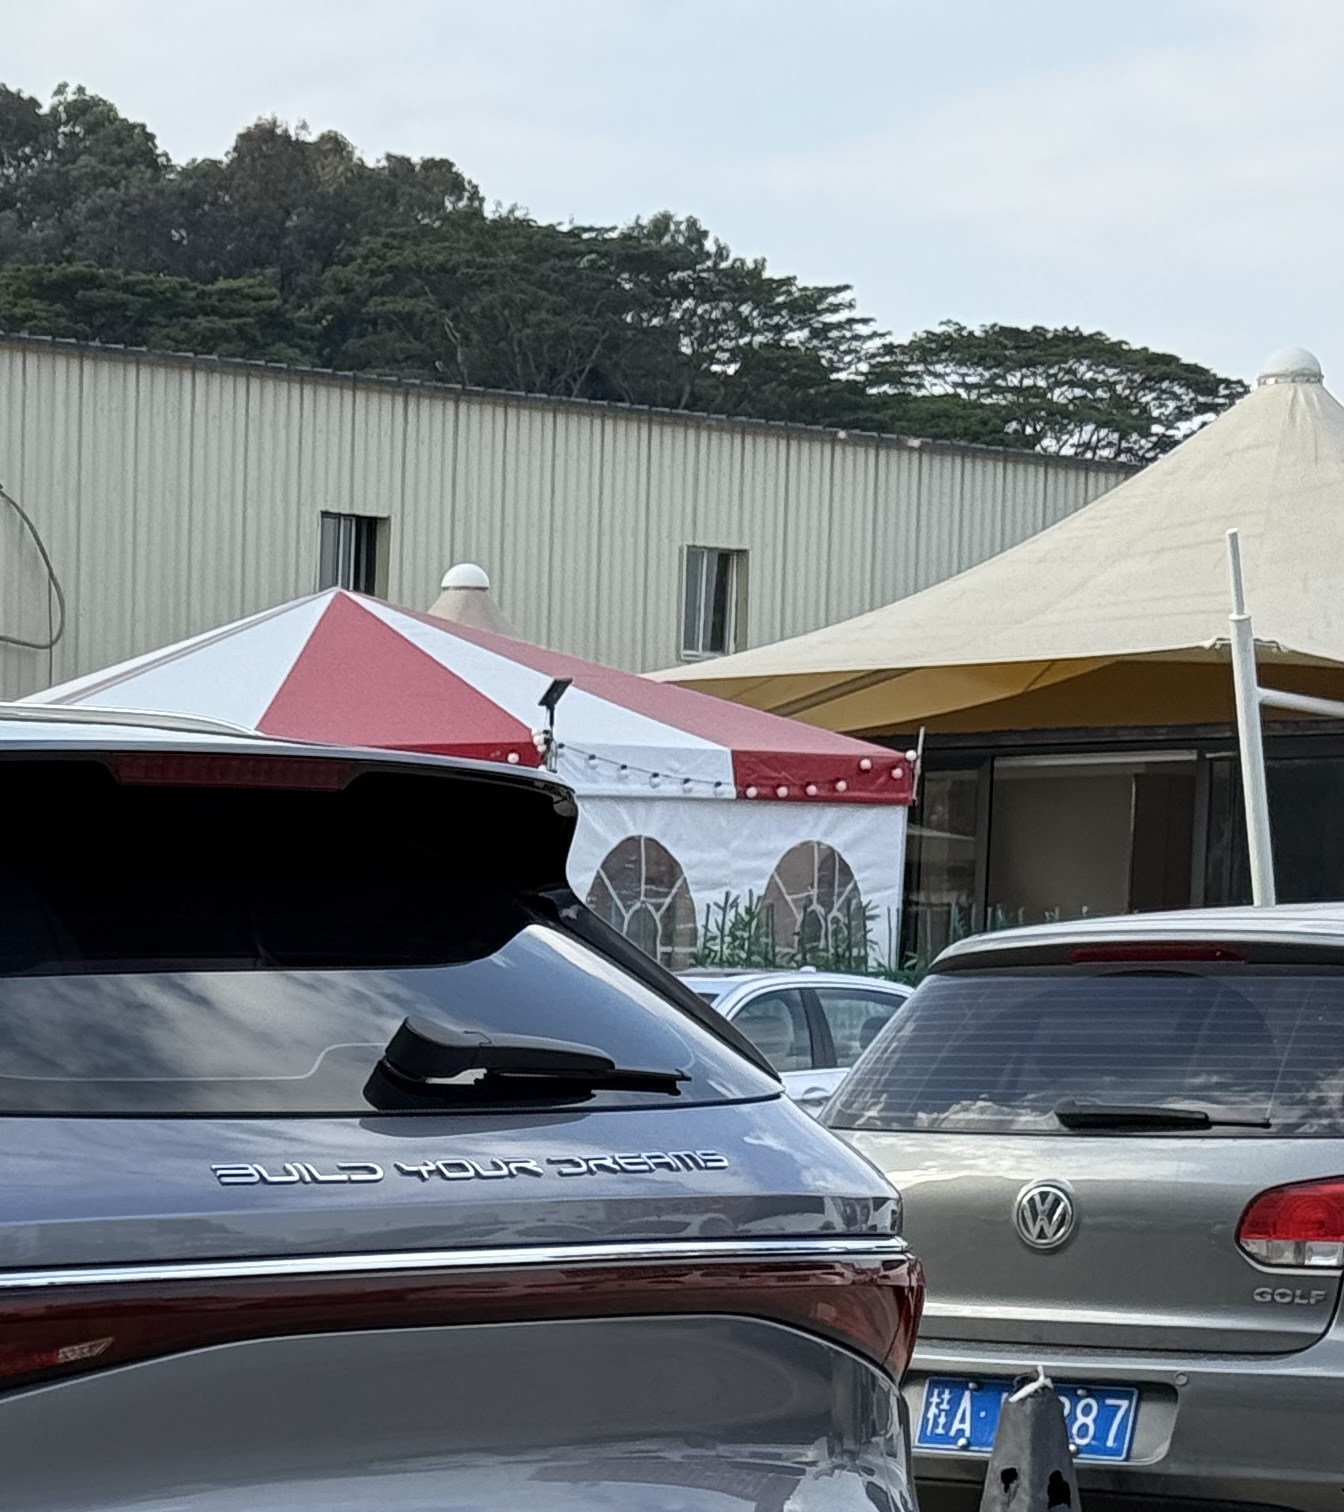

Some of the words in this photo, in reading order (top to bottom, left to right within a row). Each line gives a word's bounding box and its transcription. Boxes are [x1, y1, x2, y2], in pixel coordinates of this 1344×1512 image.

[211, 1161, 384, 1186] BUILD
[393, 1157, 544, 1182] YOUR
[545, 1149, 730, 1177] DREAMS
[1252, 1287, 1326, 1305] GOLF
